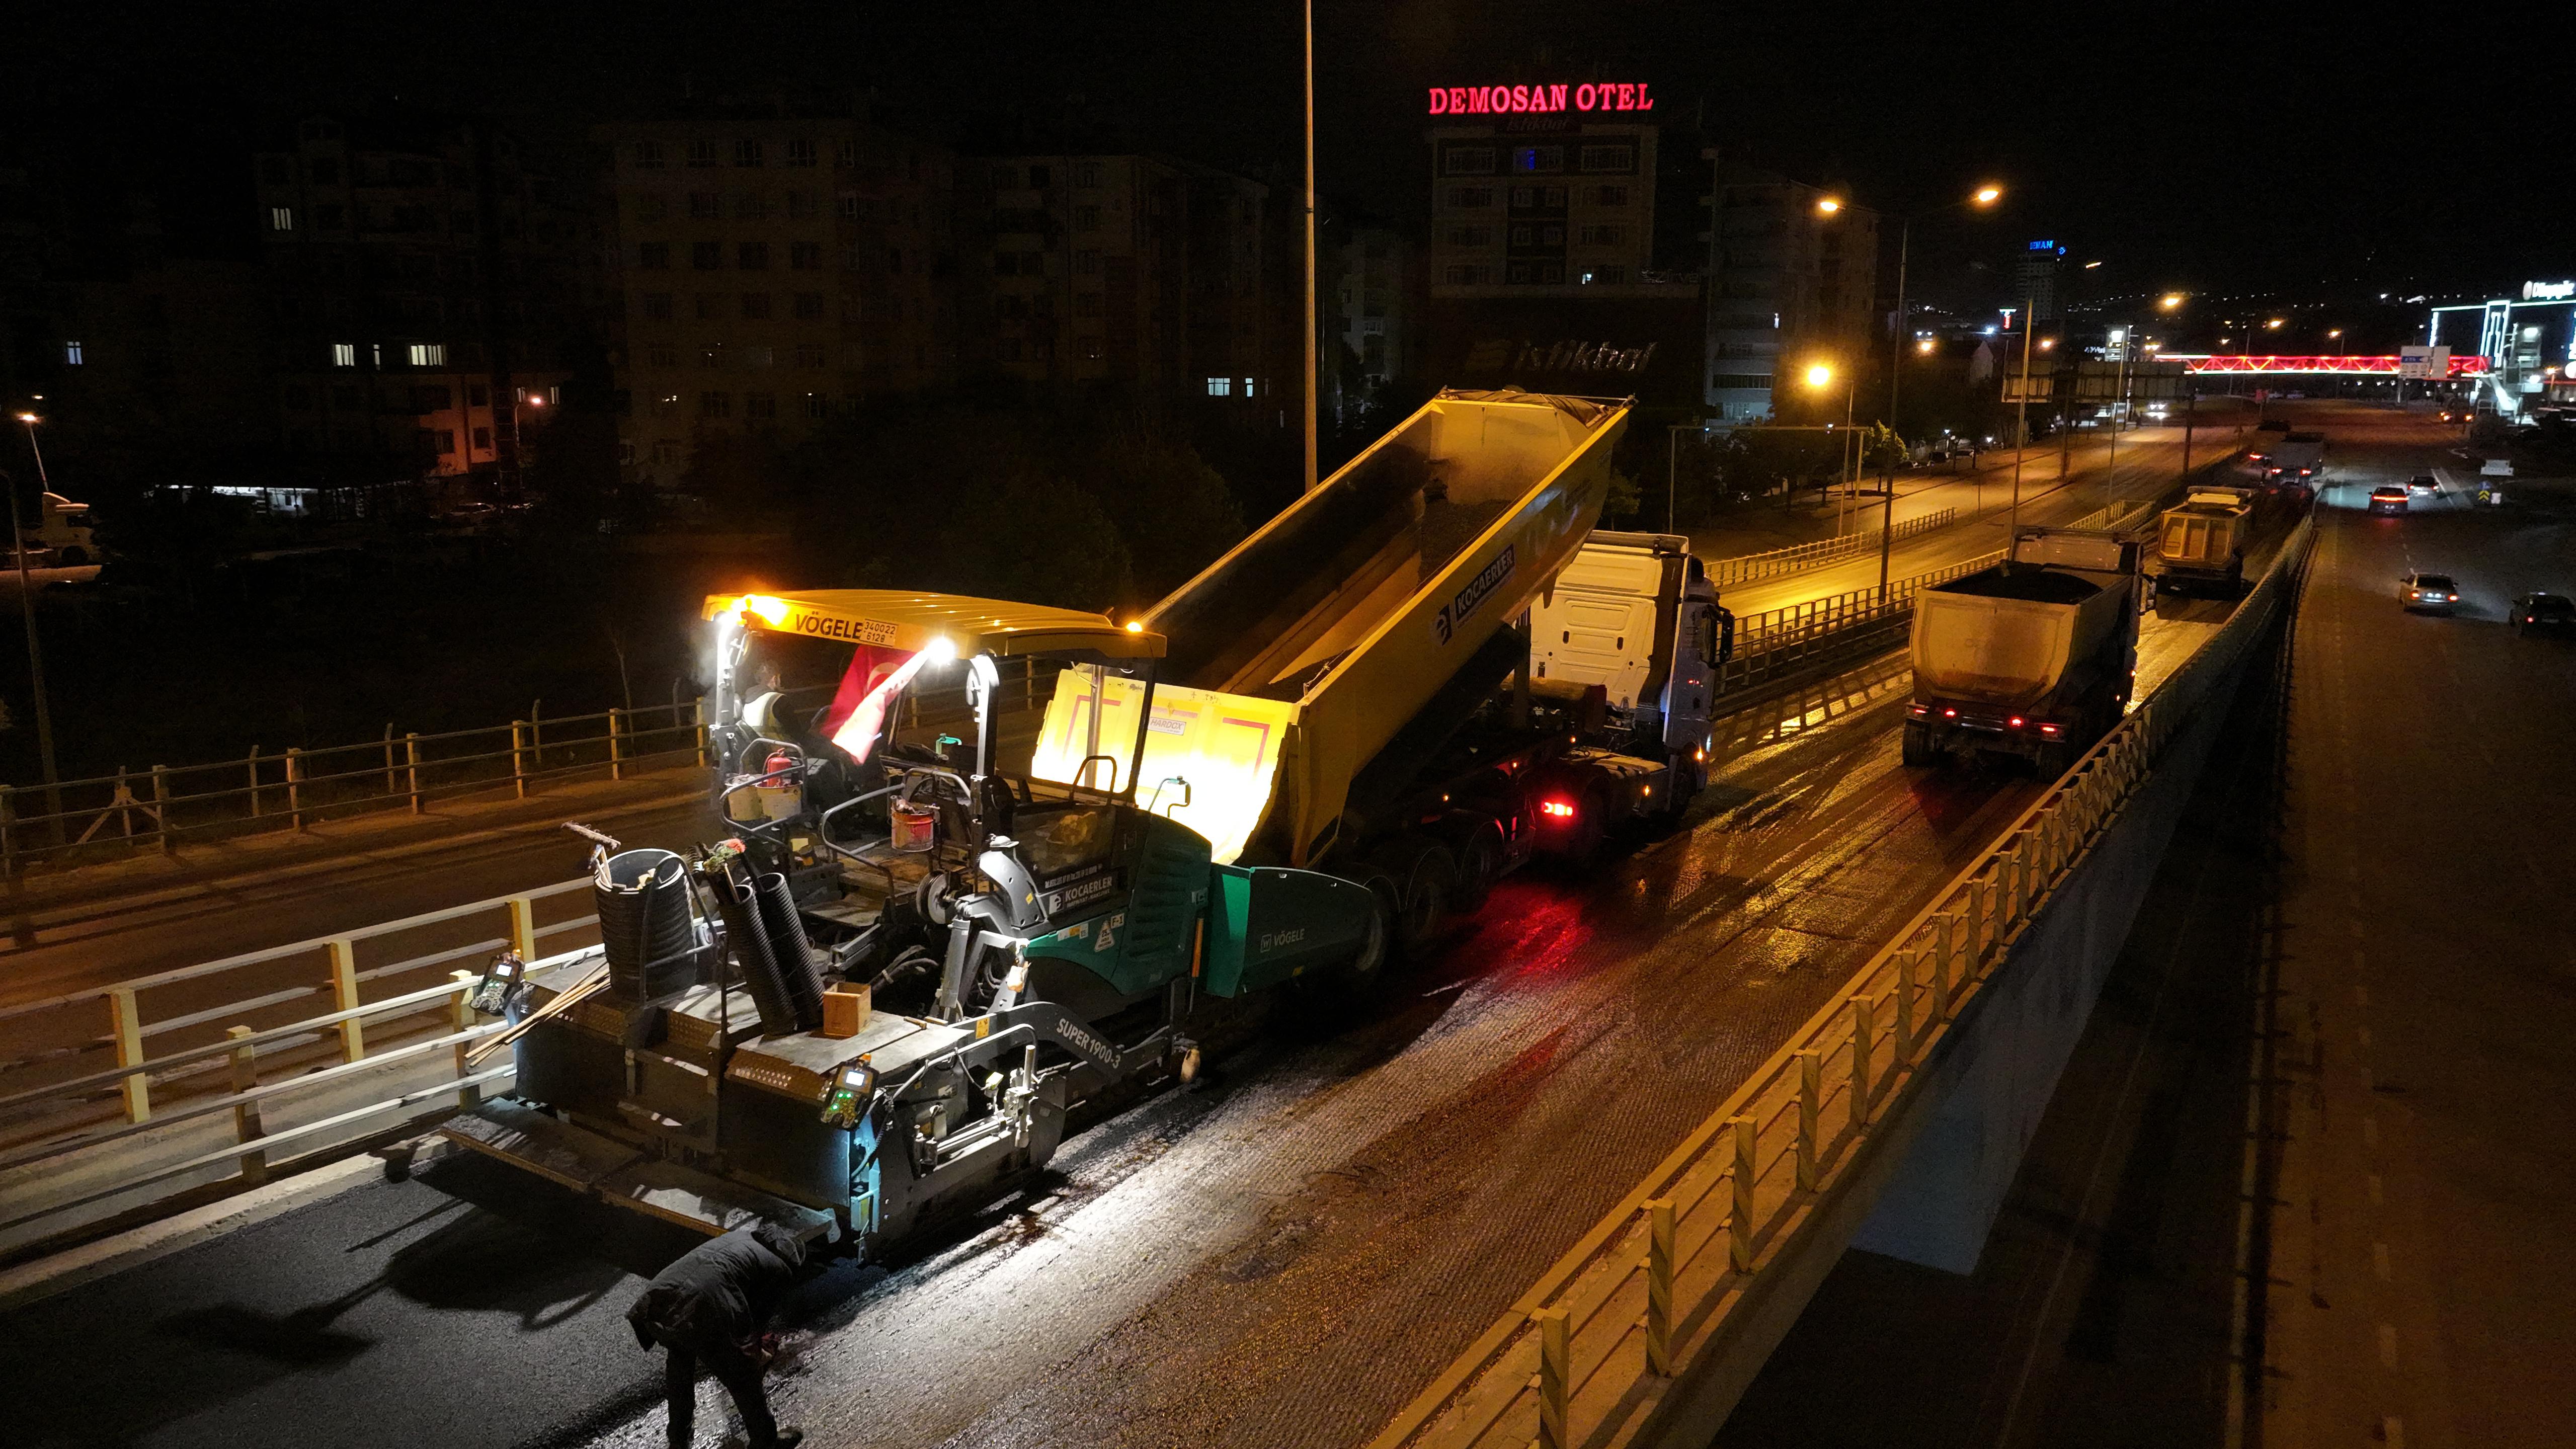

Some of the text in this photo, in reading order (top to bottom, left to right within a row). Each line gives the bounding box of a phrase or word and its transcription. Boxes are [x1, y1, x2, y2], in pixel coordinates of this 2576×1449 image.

[1429, 83, 1654, 114] DEMOSAN OTEL
[1457, 549, 1514, 614] KOCAERLER
[795, 611, 863, 640] VÖGELE
[864, 622, 896, 635] 340022
[1150, 719, 1182, 729] HARDOX
[1065, 876, 1112, 902] KOCAERLER
[1274, 928, 1305, 946] VÖGELE
[1057, 1018, 1121, 1069] SUPER 1900-3
